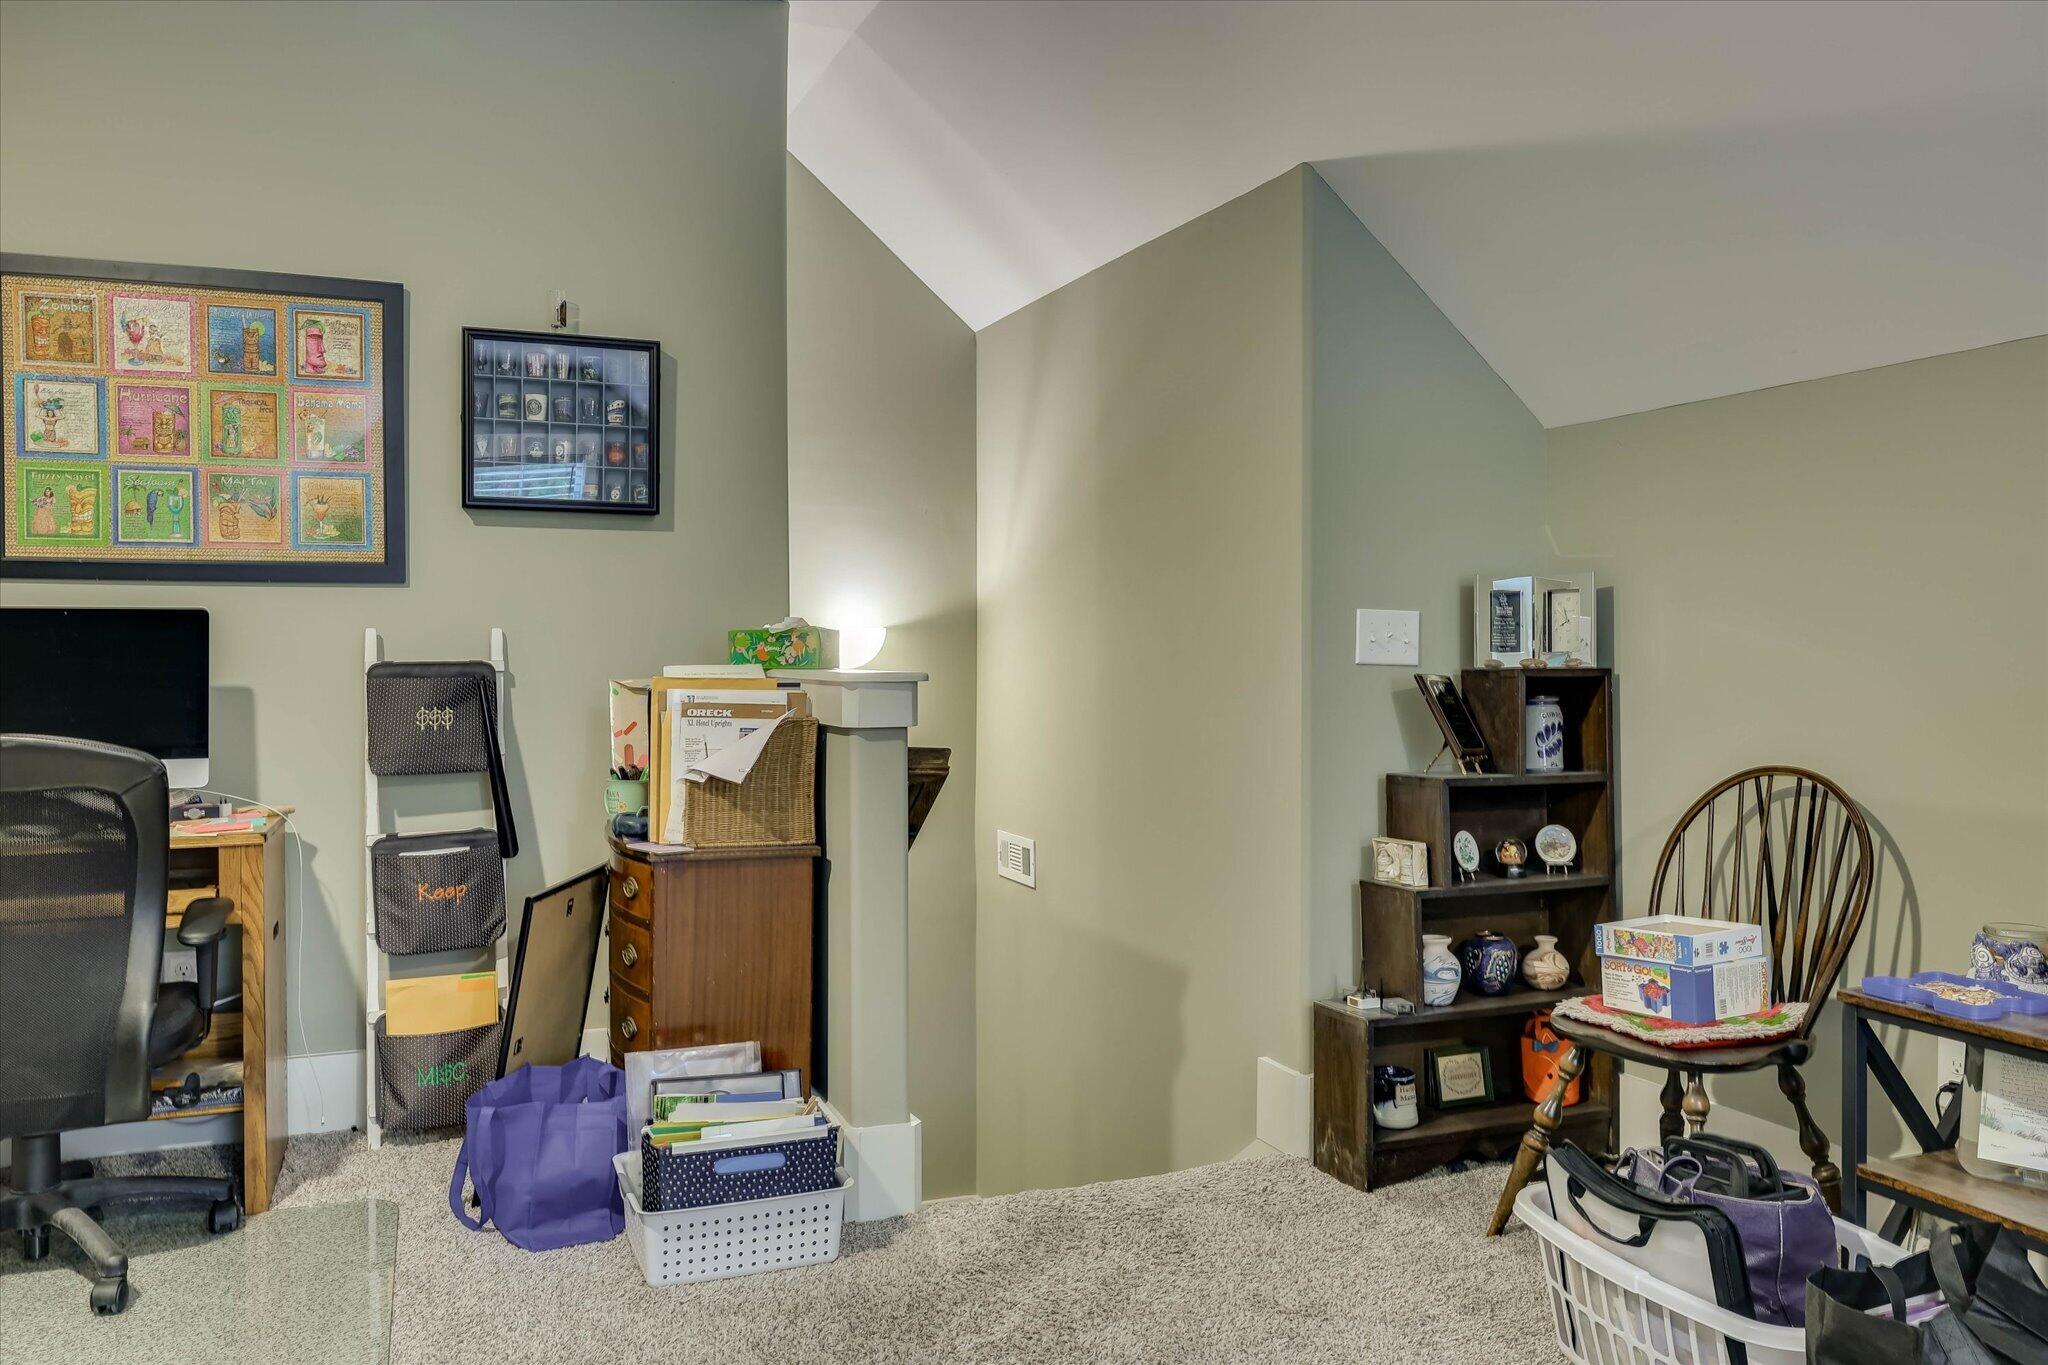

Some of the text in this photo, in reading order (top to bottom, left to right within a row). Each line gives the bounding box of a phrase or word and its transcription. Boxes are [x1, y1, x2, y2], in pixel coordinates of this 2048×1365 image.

[40, 299, 89, 312] Zombie
[120, 387, 188, 405] Hurricane
[296, 394, 364, 409] Bahama Mama
[31, 471, 95, 481] Fuzzy Navel
[687, 708, 732, 717] ORECK
[696, 719, 710, 727] Hotel
[711, 719, 733, 728] Uprights
[418, 883, 467, 906] Keep
[1604, 959, 1626, 973] SORT
